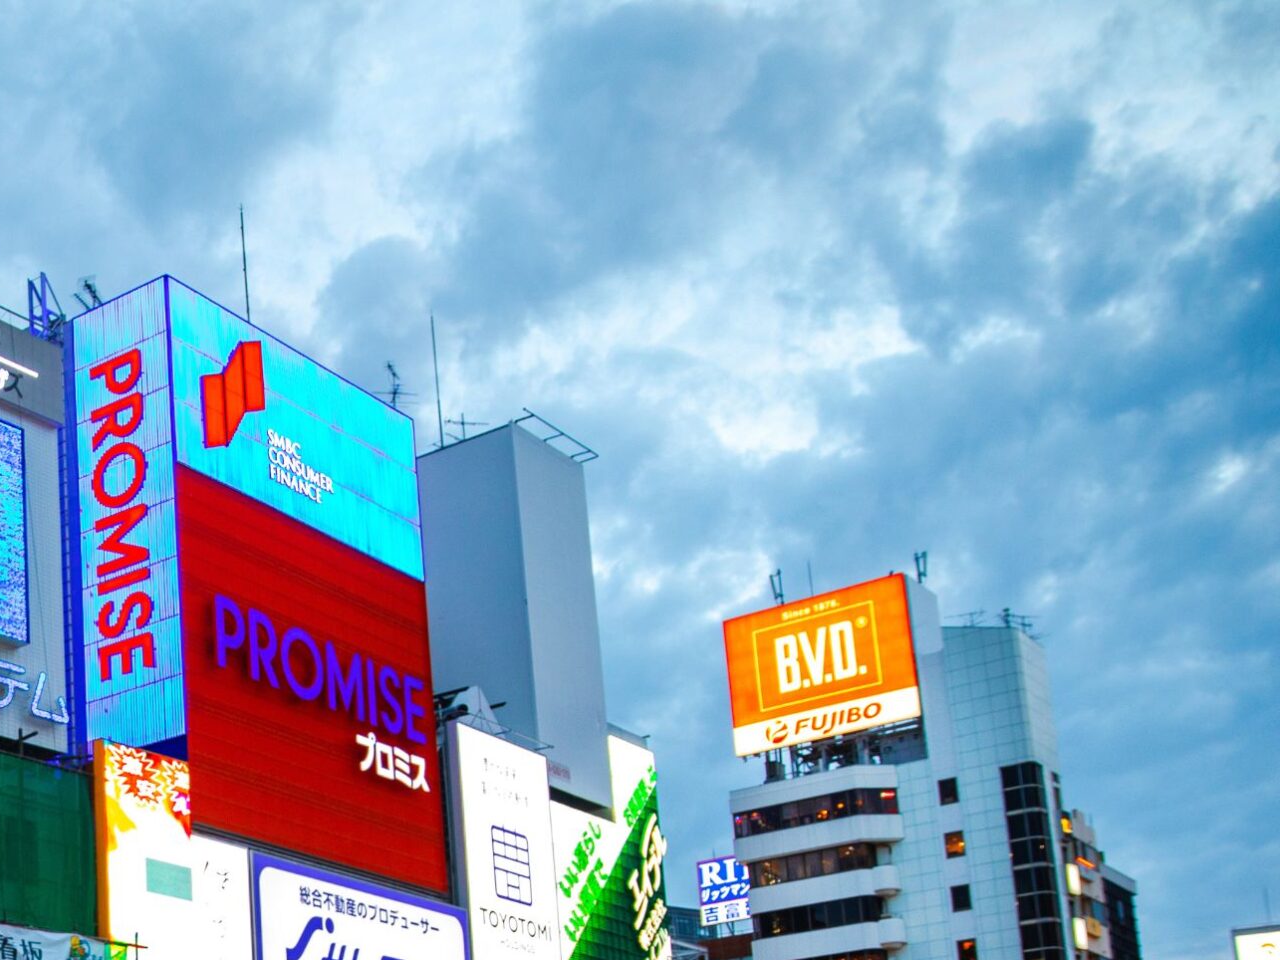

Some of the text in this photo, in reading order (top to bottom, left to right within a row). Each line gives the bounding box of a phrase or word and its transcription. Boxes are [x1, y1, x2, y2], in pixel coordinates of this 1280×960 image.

[267, 429, 302, 460] SMBC
[268, 446, 334, 495] CONSUMER
[269, 465, 322, 504] FINANCE
[89, 348, 155, 682] PROMISE
[214, 592, 427, 745] PROMISE
[774, 620, 868, 694] B.V.D.
[794, 702, 883, 735] FUJIBO
[355, 731, 431, 793] プロミス
[299, 885, 440, 934] 総合不動産のプロデューサー
[703, 902, 750, 922] 吉富
